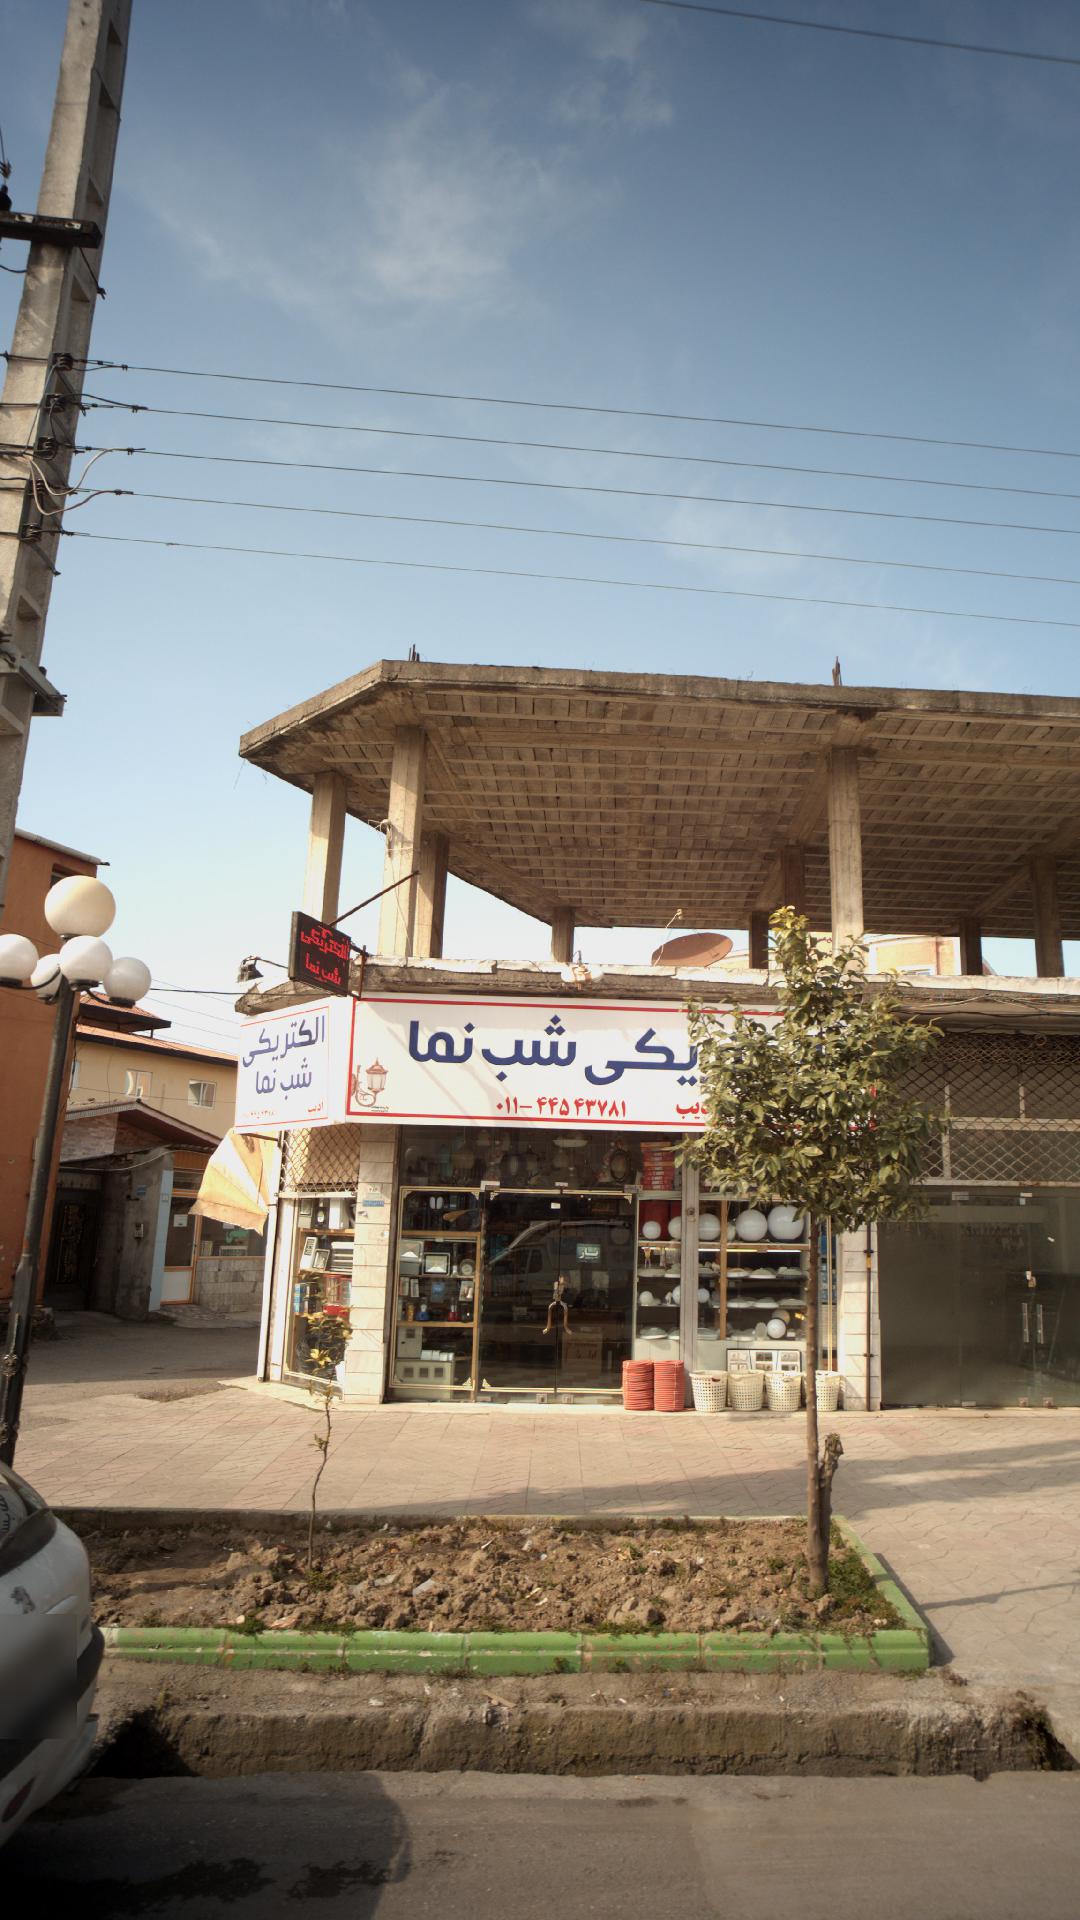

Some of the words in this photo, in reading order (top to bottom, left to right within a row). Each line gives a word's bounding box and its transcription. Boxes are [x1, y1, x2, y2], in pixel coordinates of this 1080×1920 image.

[242, 1015, 325, 1068] الکتریکی
[408, 1020, 475, 1064] نما
[481, 1014, 577, 1082] شب
[255, 1069, 277, 1094] نما
[280, 1057, 312, 1100] شب
